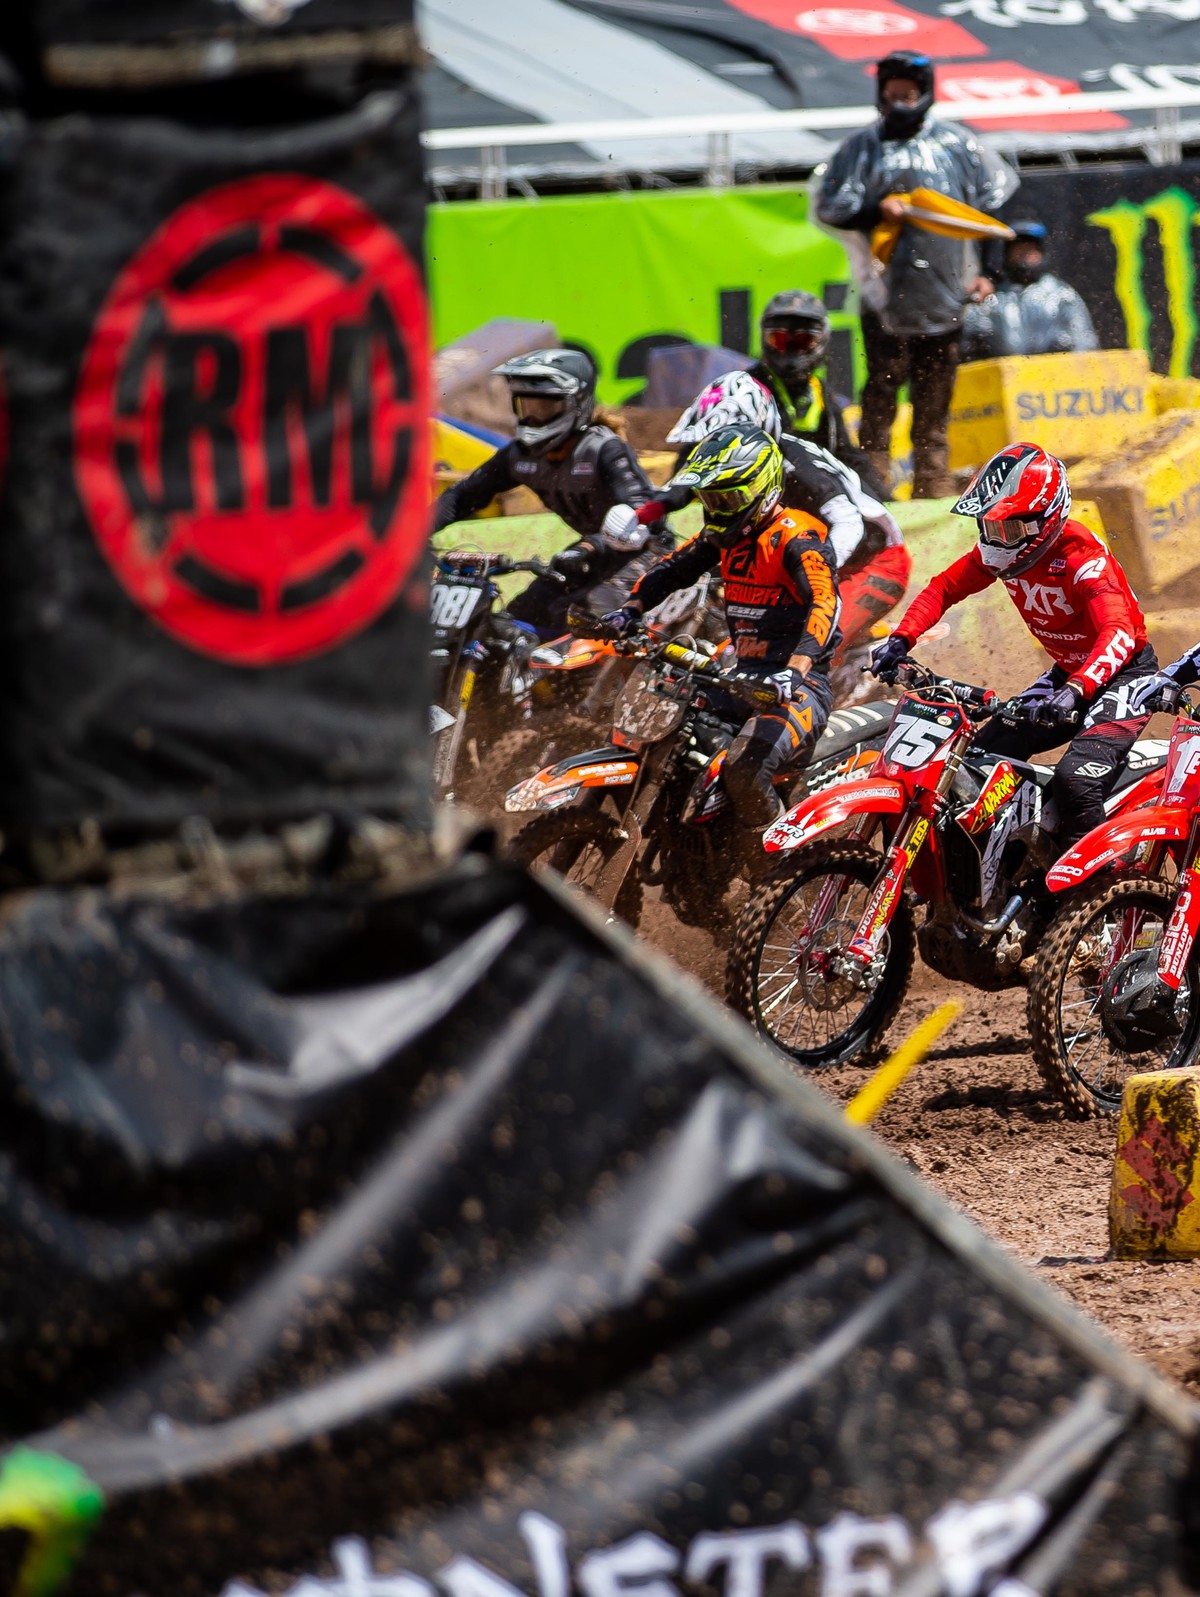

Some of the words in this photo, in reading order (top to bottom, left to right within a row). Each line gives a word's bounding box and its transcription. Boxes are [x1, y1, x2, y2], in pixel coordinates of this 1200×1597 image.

[157, 324, 374, 513] RM
[1016, 386, 1146, 421] SUZUKI
[1033, 628, 1087, 642] HONDA
[1083, 629, 1136, 686] FXR
[913, 702, 938, 715] MONSTER
[1128, 758, 1160, 770] GUTS
[1048, 875, 1071, 883] HONDA
[1049, 865, 1084, 877] GEICO
[858, 879, 887, 937] DUNLOP
[870, 891, 896, 938] SUNSTAR
[1158, 891, 1192, 974] GEICO
[1170, 923, 1190, 976] DUNLOP
